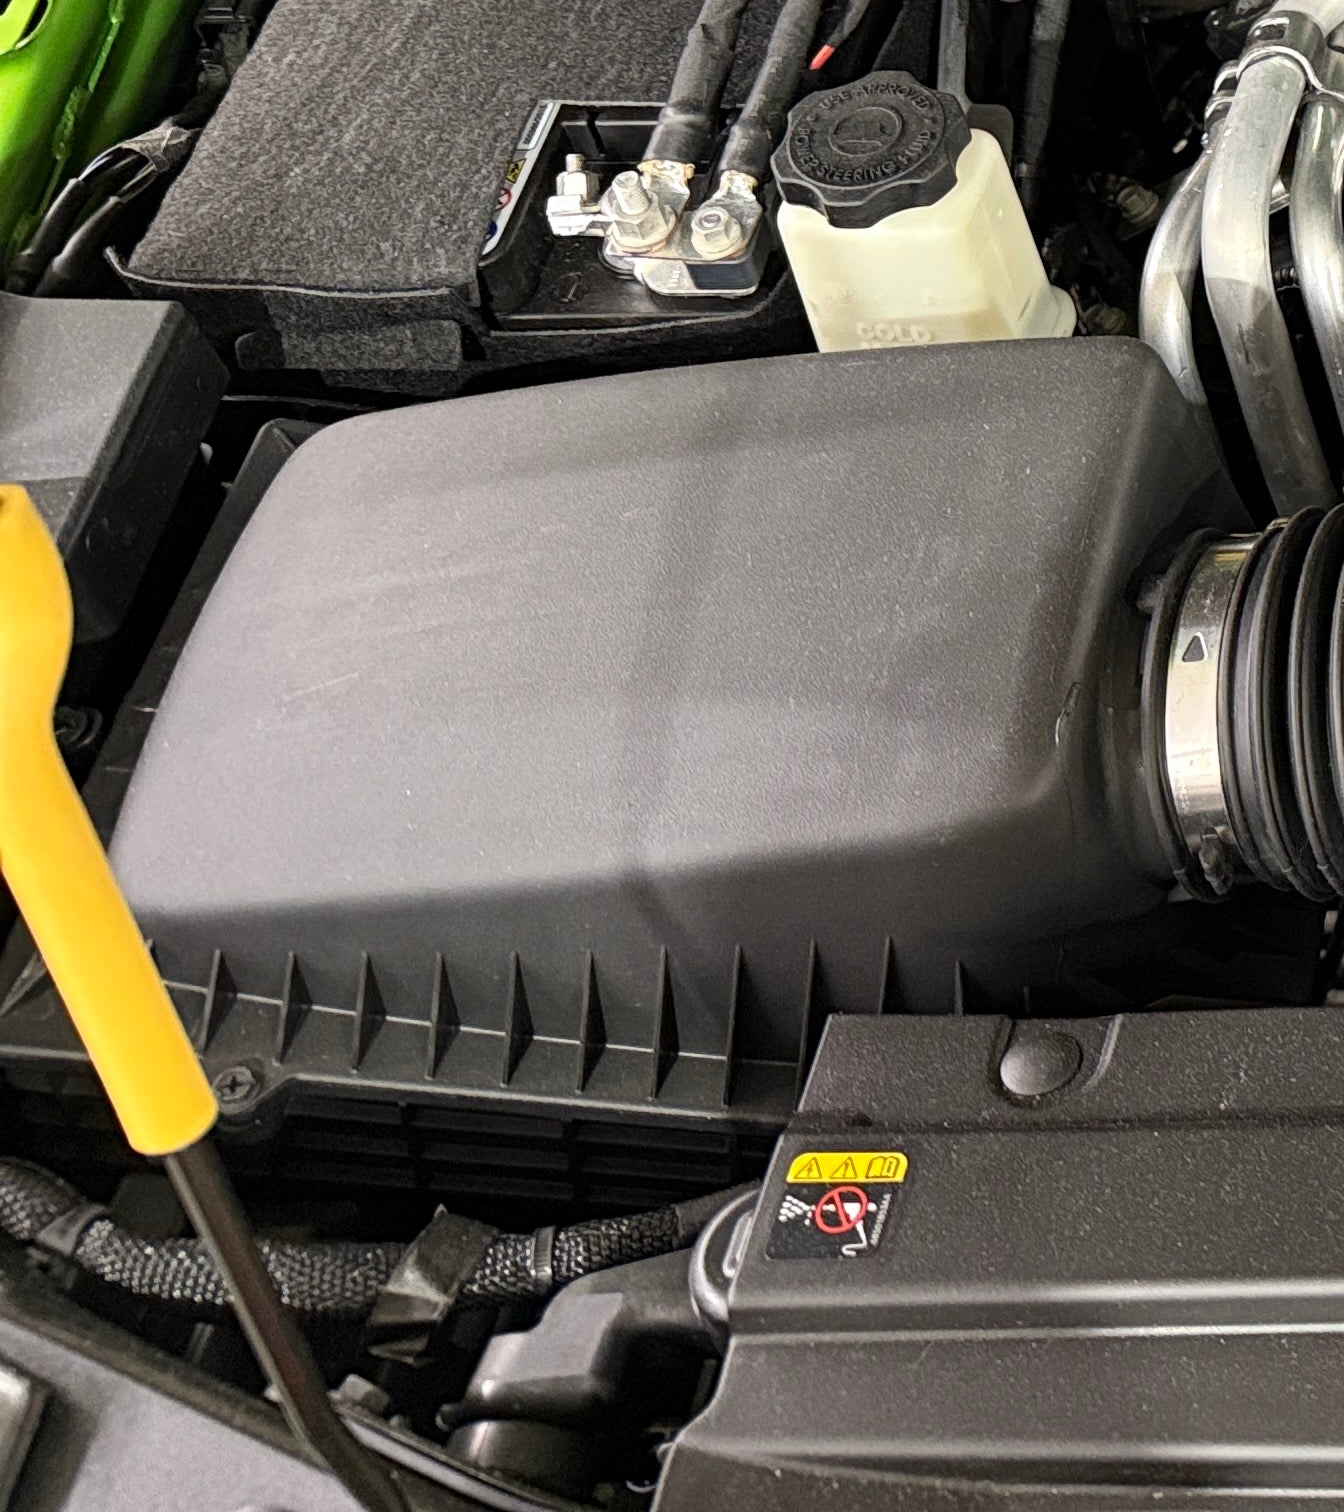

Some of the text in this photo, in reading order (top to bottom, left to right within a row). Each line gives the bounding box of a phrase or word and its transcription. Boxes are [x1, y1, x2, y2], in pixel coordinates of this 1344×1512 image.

[819, 81, 931, 112] USE APPROVED
[816, 159, 897, 184] STEERING
[855, 321, 932, 342] COLD
